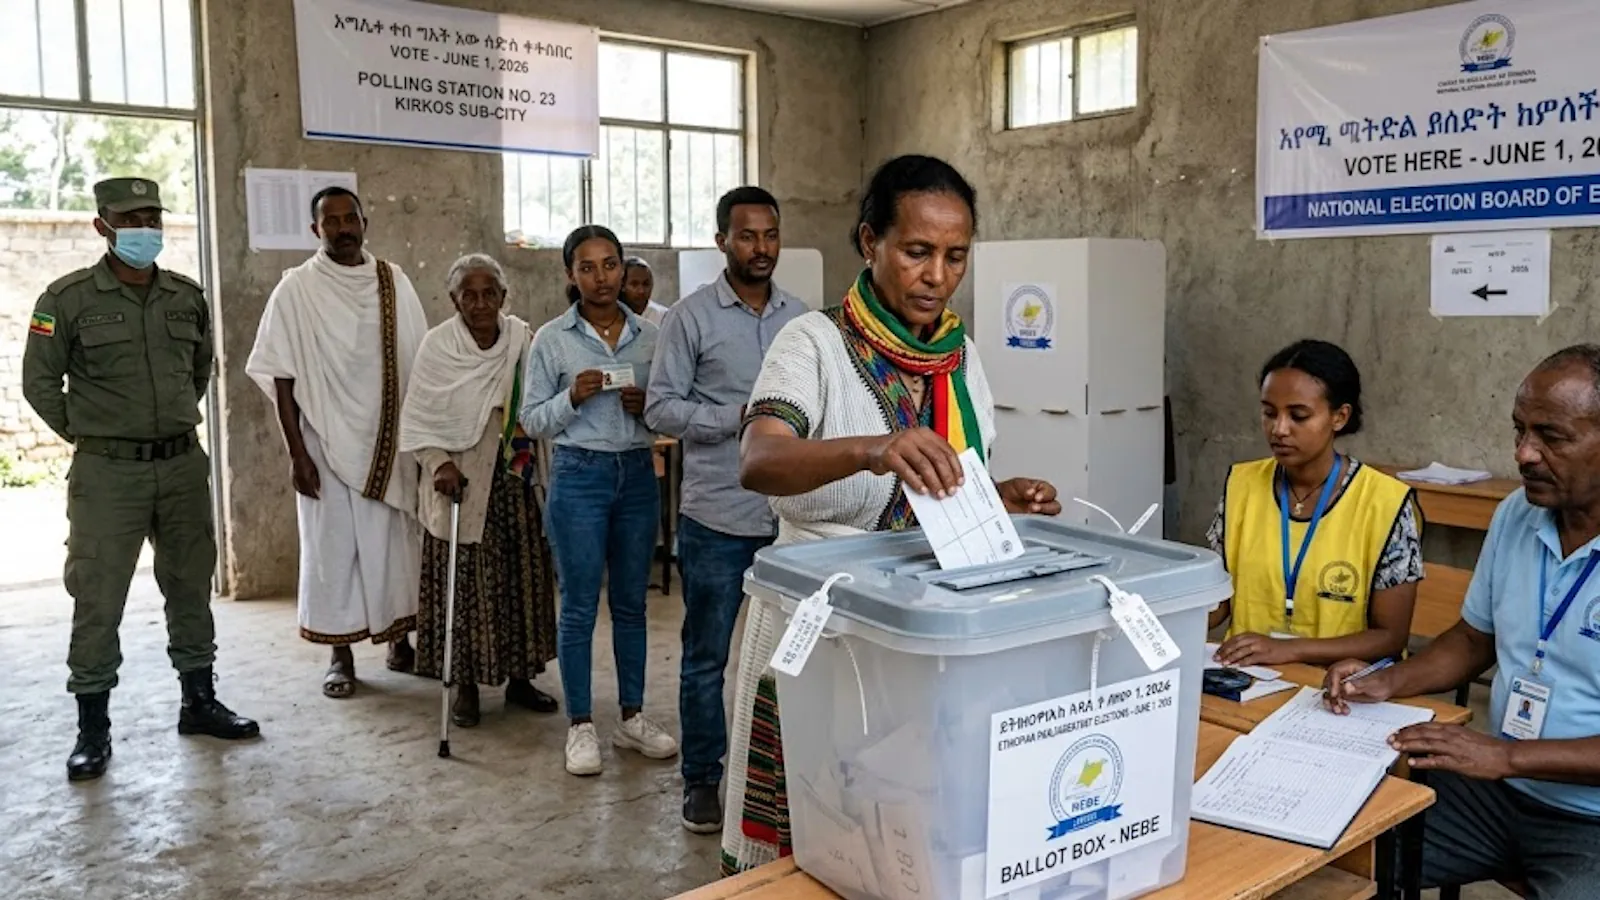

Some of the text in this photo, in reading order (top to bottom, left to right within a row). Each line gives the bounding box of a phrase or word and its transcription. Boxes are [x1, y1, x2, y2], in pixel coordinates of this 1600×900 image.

[390, 45, 429, 61] VOTE
[442, 52, 479, 68] JUNE
[484, 57, 495, 71] 1,
[499, 58, 529, 73] 2026
[358, 71, 556, 106] POLLING STATION NO. 23
[395, 97, 527, 122] KIRKOS SUB-CITY
[1344, 153, 1397, 176] VOTE
[1404, 148, 1462, 172] HERE
[1483, 141, 1545, 166] JUNE
[1555, 139, 1573, 163] 1,
[1582, 136, 1600, 158] 2
[1308, 198, 1386, 218] NATIONAL
[1390, 192, 1476, 214] ELECTION
[1481, 187, 1550, 209] BOARD
[1555, 185, 1583, 205] OF
[1001, 847, 1067, 884] BALLOT
[1072, 834, 1106, 860] BOX
[1120, 815, 1160, 844] NEBE
